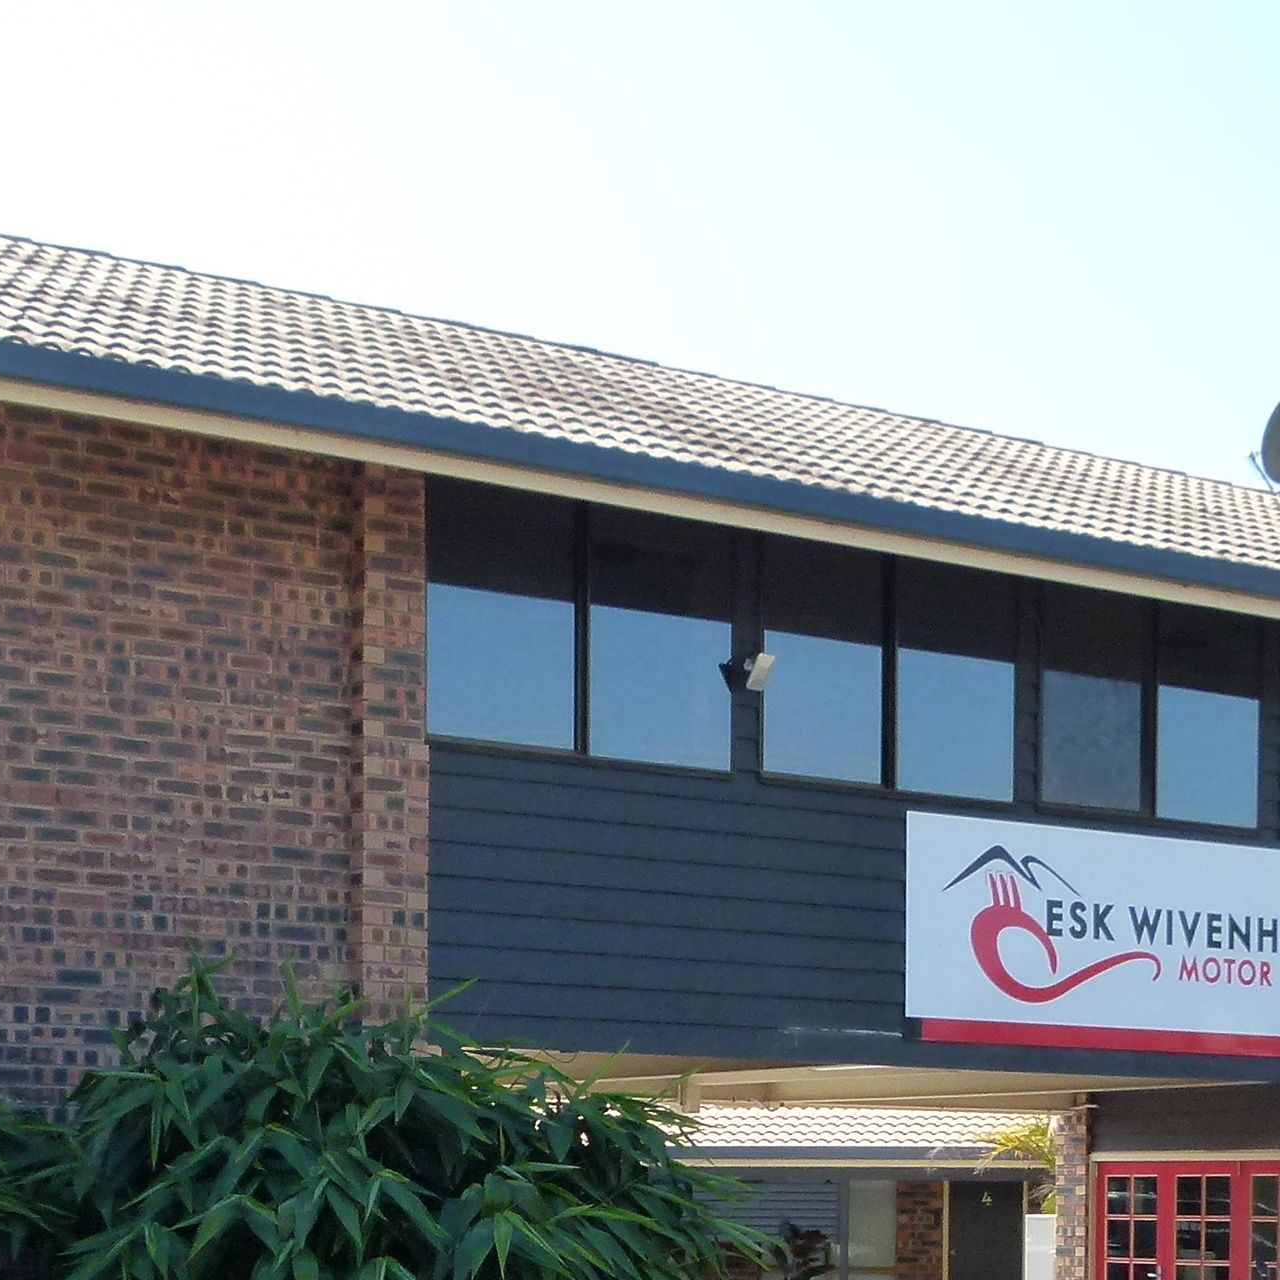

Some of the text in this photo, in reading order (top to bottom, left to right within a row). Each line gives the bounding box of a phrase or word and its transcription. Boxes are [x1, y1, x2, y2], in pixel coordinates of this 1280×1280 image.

[1046, 899, 1115, 942] ESK
[1178, 954, 1273, 987] MOTOR
[981, 1191, 992, 1207] 4
